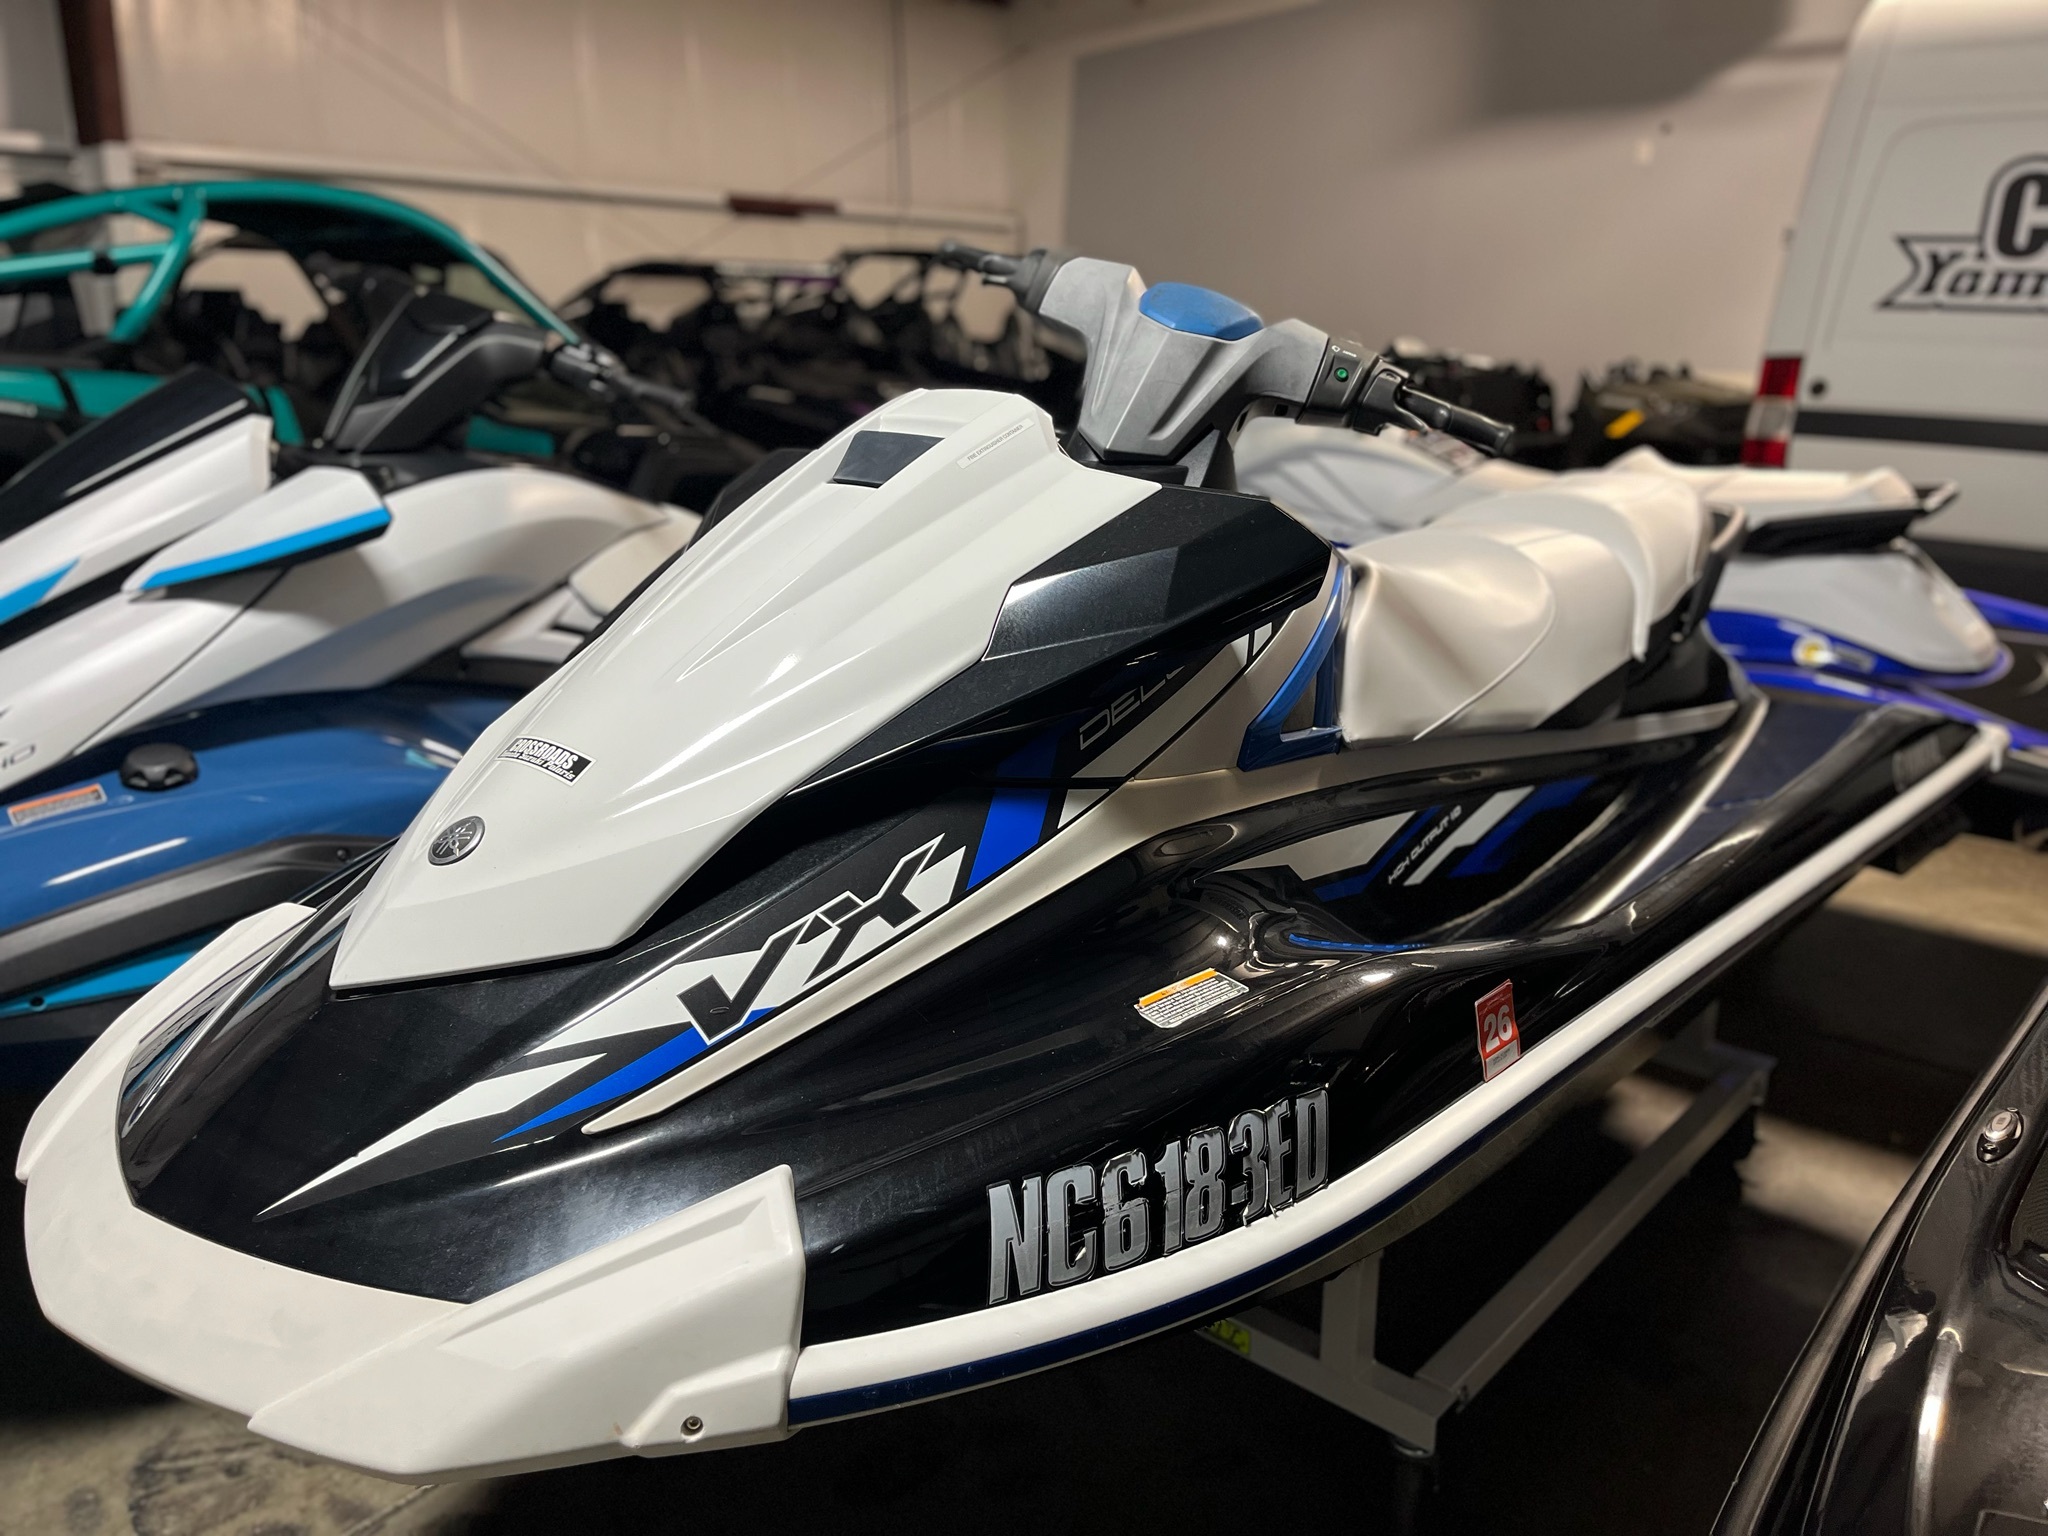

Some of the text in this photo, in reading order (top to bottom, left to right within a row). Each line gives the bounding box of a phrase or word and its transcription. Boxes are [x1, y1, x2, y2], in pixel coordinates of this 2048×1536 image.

[508, 738, 579, 770] CROSSROADS
[542, 759, 576, 781] Polaris
[1410, 815, 1450, 860] OUTPUT
[676, 833, 945, 1044] VX
[1483, 1004, 1513, 1053] 26
[987, 1087, 1330, 1305] NC6183ED
